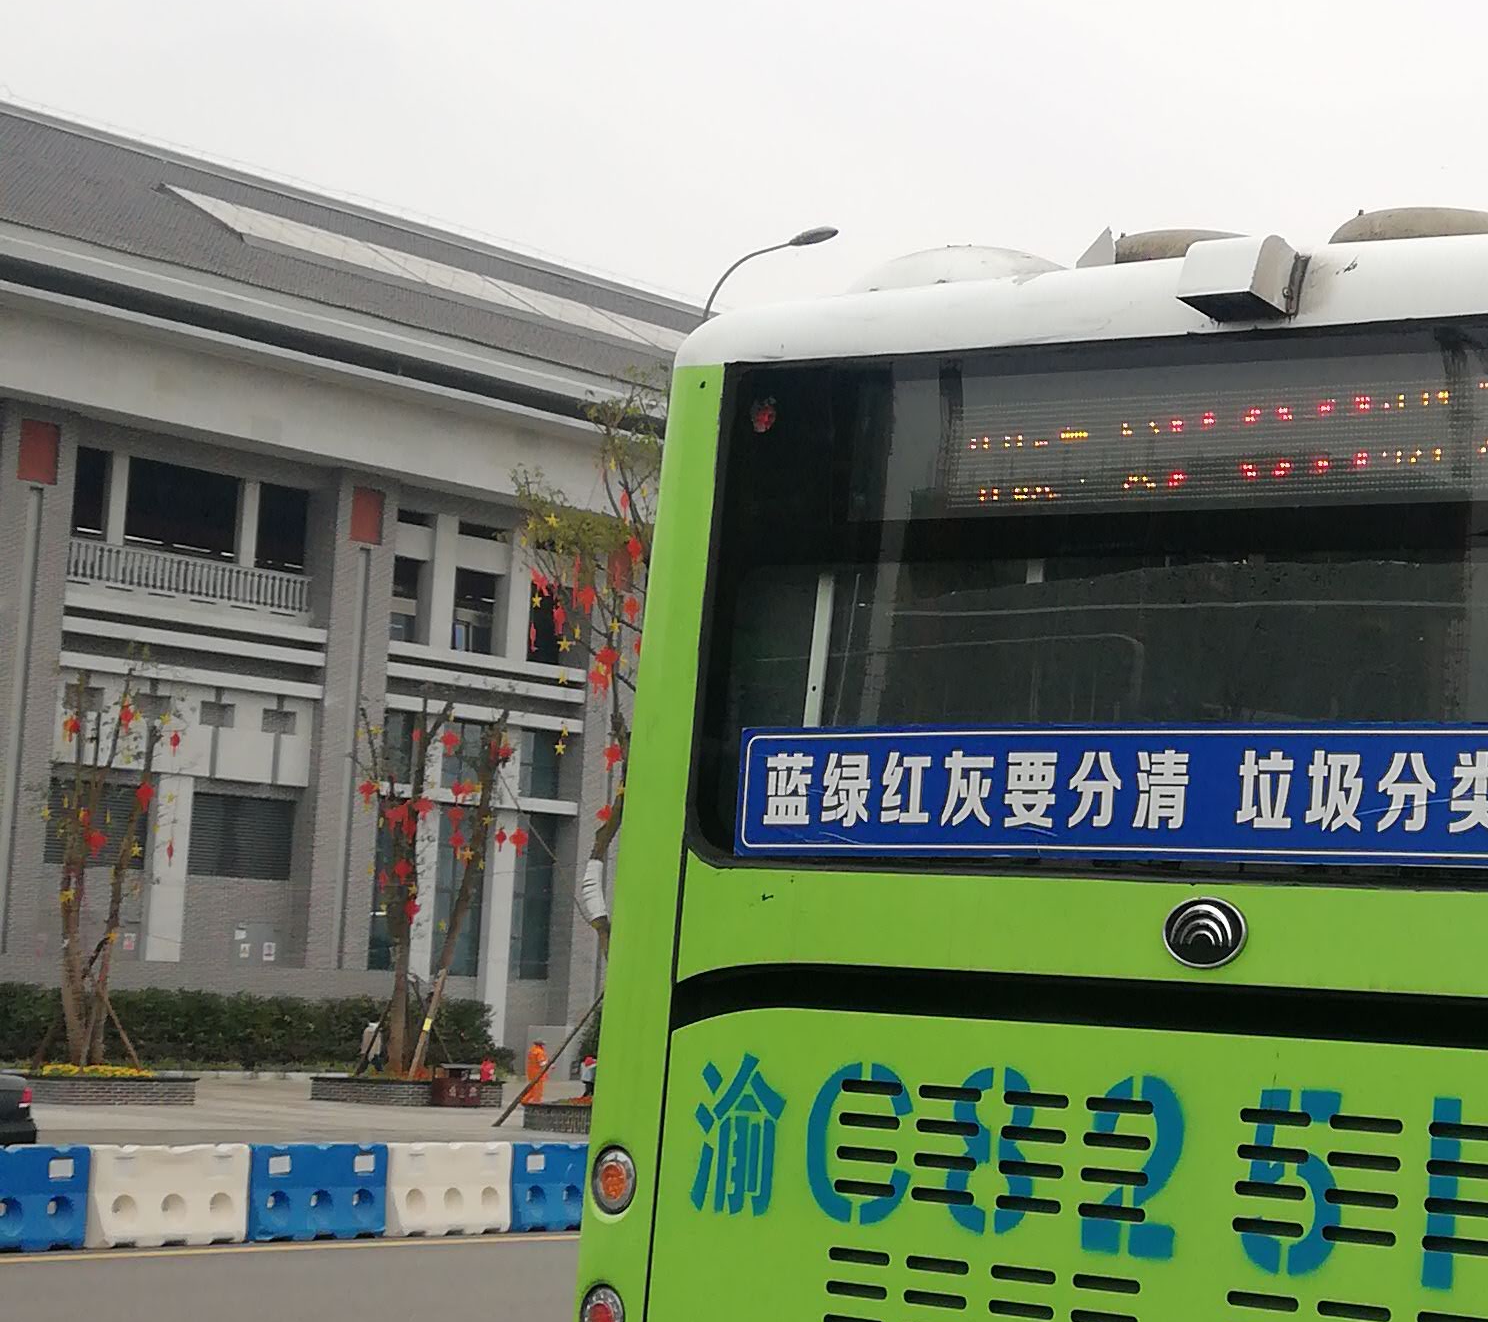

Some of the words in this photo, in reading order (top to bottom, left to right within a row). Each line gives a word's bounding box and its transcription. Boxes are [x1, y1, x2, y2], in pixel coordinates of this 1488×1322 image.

[763, 750, 1190, 830] 蓝绿红灰要分清
